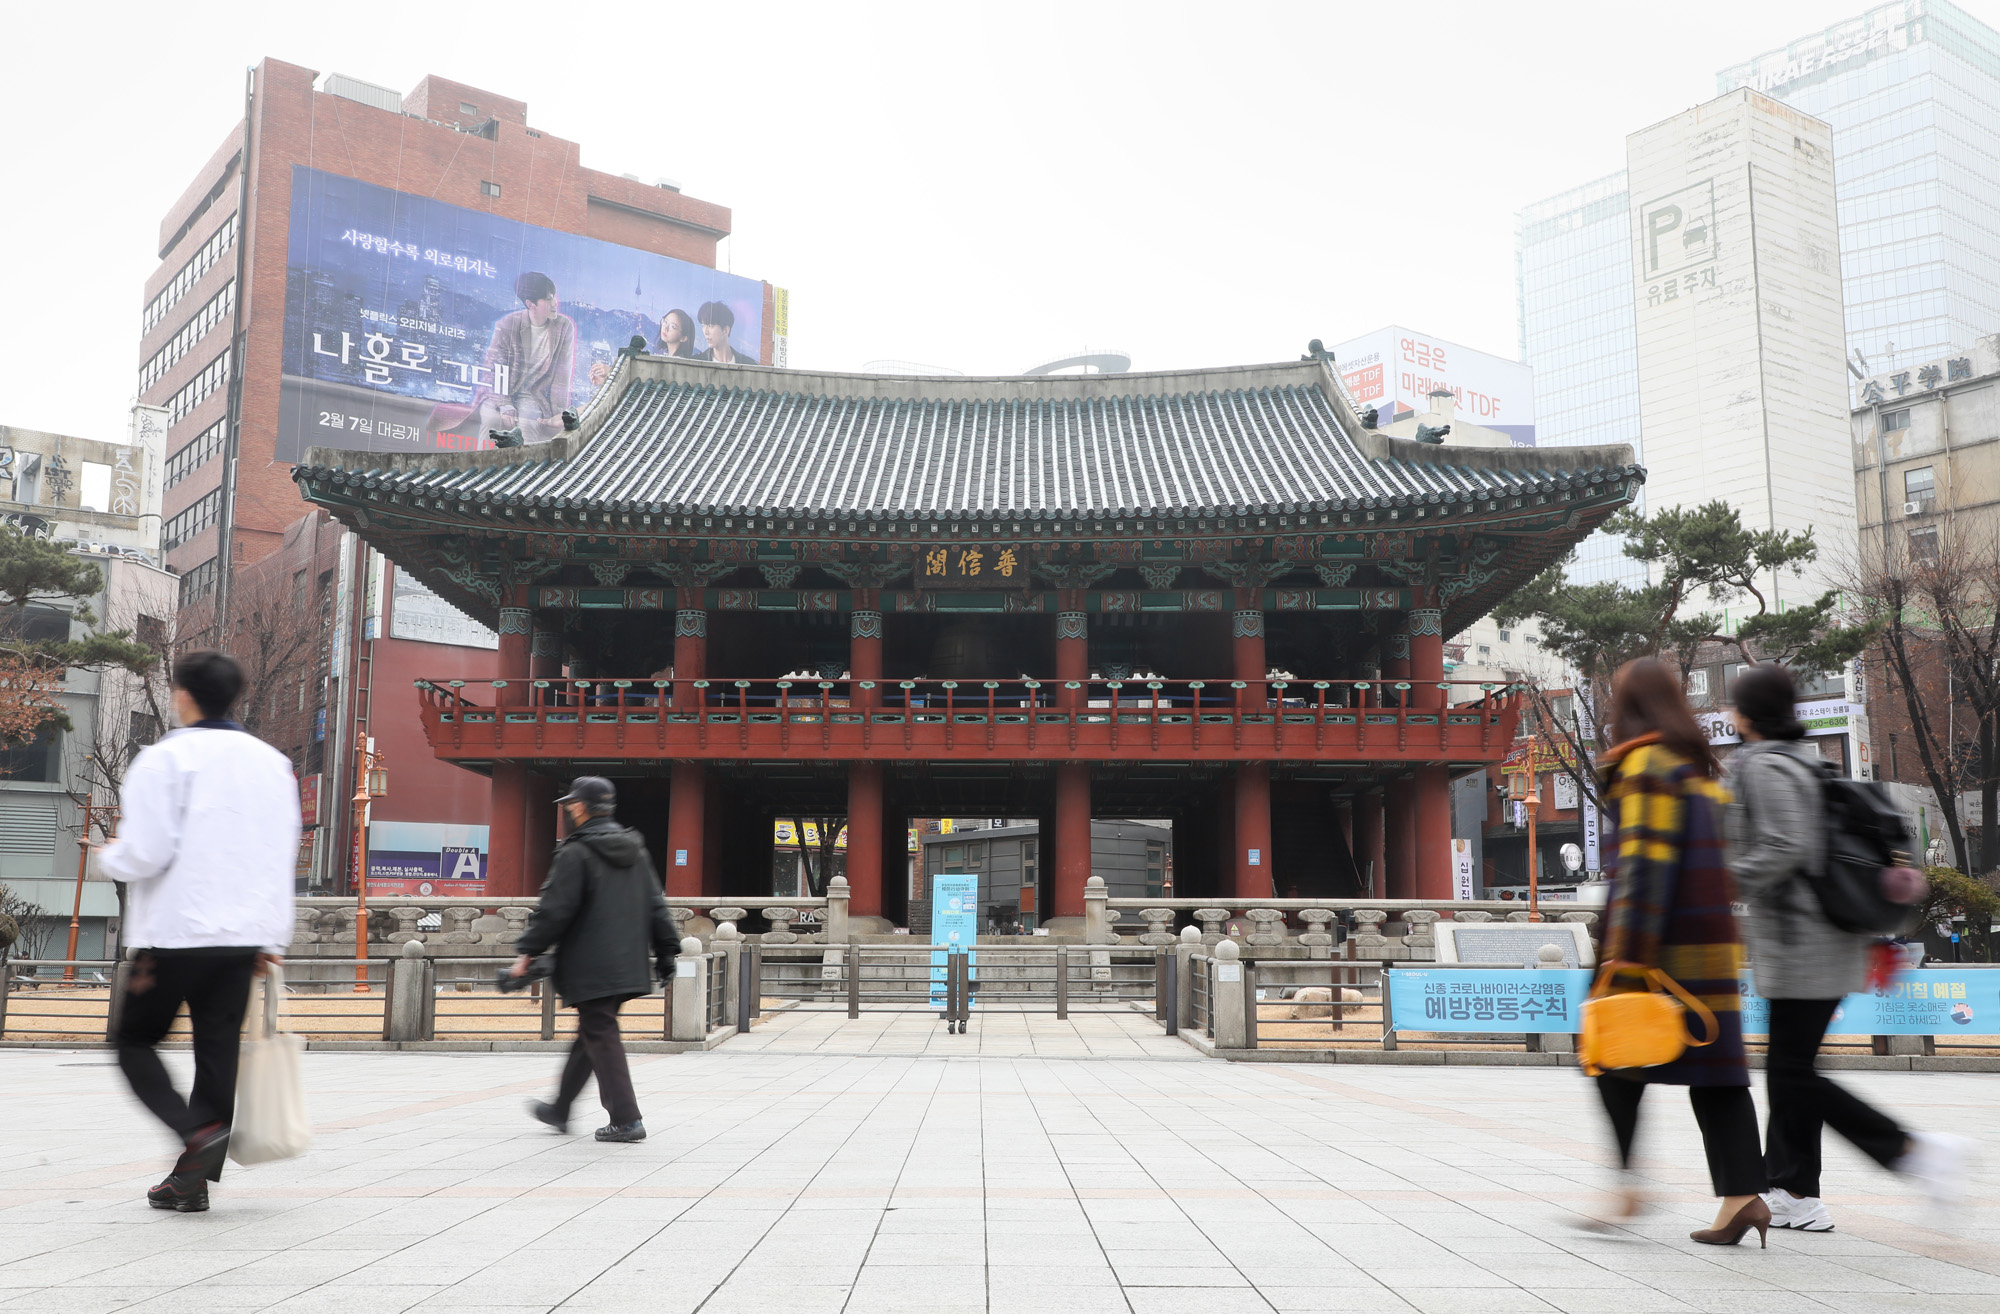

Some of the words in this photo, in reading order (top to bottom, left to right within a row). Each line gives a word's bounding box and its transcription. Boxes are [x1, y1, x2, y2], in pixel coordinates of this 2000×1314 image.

[1649, 205, 1683, 272] P
[341, 229, 420, 261] 사랑할수록
[424, 249, 497, 278] 외로워지는
[1647, 279, 1679, 308] 유료
[1684, 266, 1715, 294] 주차
[360, 308, 398, 325] 넷플릭스
[400, 318, 436, 334] 오리지널
[438, 325, 466, 340] 시리즈
[313, 331, 355, 365] 나
[359, 332, 432, 385] 홀로
[436, 359, 510, 396] 그대
[1400, 338, 1447, 372] 연금은
[1362, 367, 1381, 383] TDF
[1363, 383, 1382, 400] TDF
[1467, 390, 1501, 419] TDF
[319, 412, 345, 429] 2월
[349, 416, 373, 434] 7일
[378, 421, 420, 442] 대공개
[1586, 820, 1596, 848] BAR
[451, 853, 480, 879] A
[1424, 983, 1447, 994] 신종
[1450, 983, 1566, 995] 코로나바이러스감염증
[1740, 983, 1754, 998] 2.
[1875, 984, 1890, 998] 3.
[1896, 983, 1928, 999] 기침
[1933, 982, 1967, 999] 예절
[1425, 996, 1568, 1022] 예방행동수칙
[1742, 1001, 1763, 1011] 30초
[1875, 1002, 1904, 1013] 기침은
[1908, 1002, 1947, 1013] 옷소매로
[1876, 1014, 1906, 1025] 가리고
[1909, 1014, 1941, 1025] 하세요!
